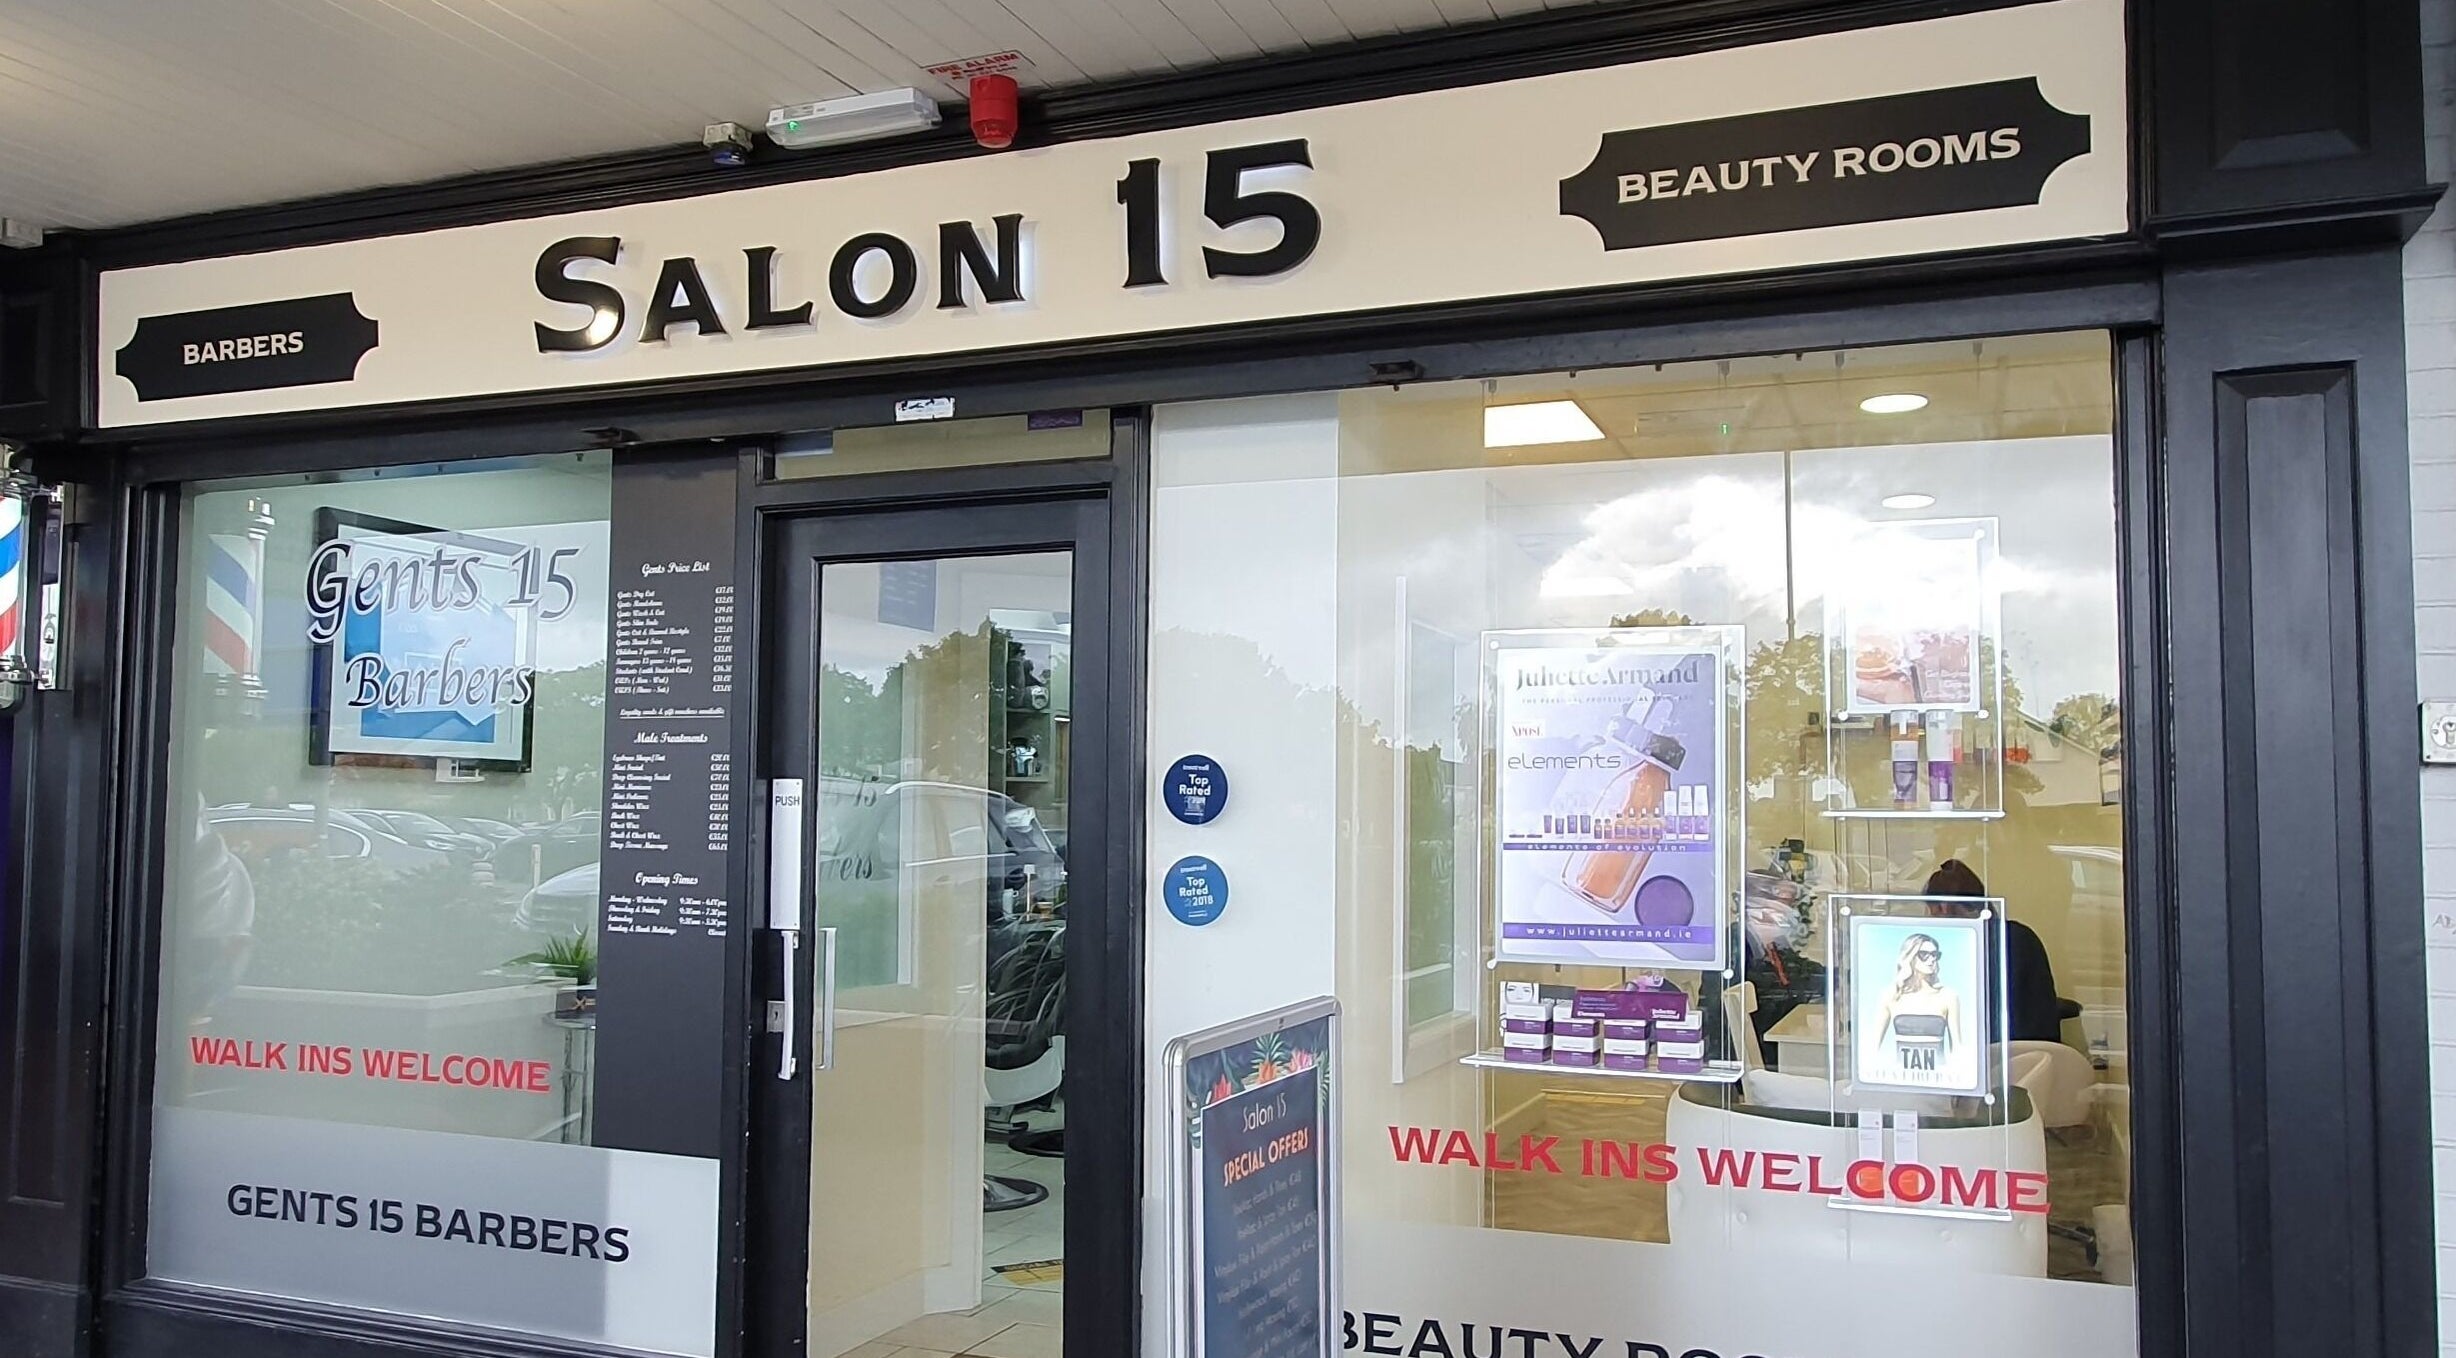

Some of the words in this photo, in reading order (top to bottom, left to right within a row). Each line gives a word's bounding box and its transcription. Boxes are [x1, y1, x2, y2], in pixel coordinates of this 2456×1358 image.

[927, 64, 962, 75] FIRE
[966, 53, 1019, 68] ALARM
[1615, 150, 1820, 205] BEAUTY
[1832, 127, 2021, 180] ROOMS
[1116, 138, 1323, 288] 15
[182, 330, 304, 366] BARBERS
[642, 563, 666, 577] Gents
[667, 562, 690, 573] Price
[692, 561, 710, 572] List
[306, 536, 487, 644] Gents
[503, 538, 585, 625] 15
[345, 635, 534, 711] Barbers
[634, 732, 659, 743] Male
[660, 732, 708, 743] Treatments
[1179, 784, 1211, 796] Rated
[1189, 774, 1209, 788] Top
[775, 795, 800, 806] PUSH
[635, 872, 670, 887] Opening
[672, 873, 698, 885] Times
[1186, 877, 1206, 889] Top
[1179, 886, 1209, 897] Rated
[1192, 895, 1214, 907] 2018
[1526, 927, 1692, 939] www.juliettearmand.ie
[189, 1036, 287, 1071] WALK
[297, 1042, 353, 1076] INS
[362, 1047, 551, 1093] WELCOME
[1901, 1048, 1935, 1070] TAN
[1243, 1102, 1274, 1133] Salon
[1276, 1092, 1287, 1119] 15
[1224, 1146, 1265, 1187] SPECIAL
[1268, 1126, 1309, 1163] OFFERS
[1388, 1124, 1562, 1176] WALK
[1581, 1139, 1679, 1183] INS
[1696, 1146, 2052, 1215] WELCOME
[226, 1182, 358, 1229] GENTS
[368, 1197, 404, 1234] 15
[414, 1203, 631, 1264] BARBERS
